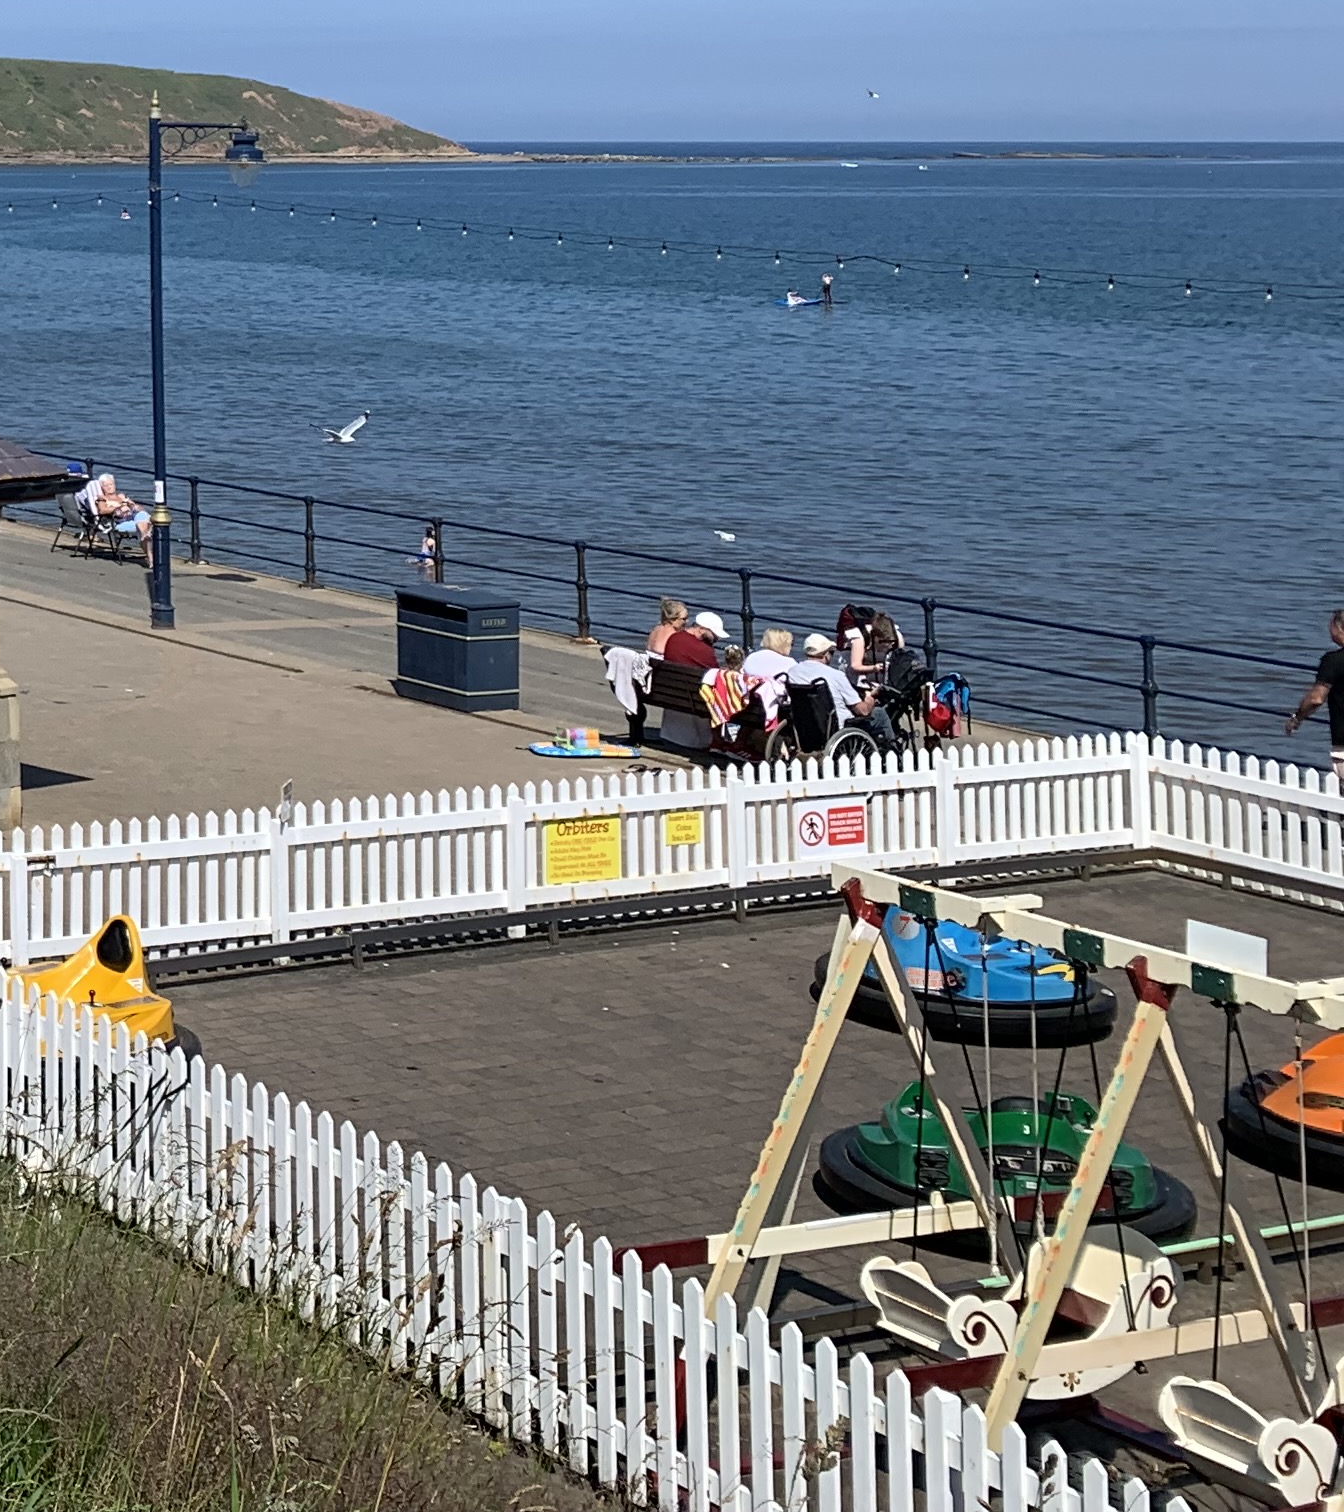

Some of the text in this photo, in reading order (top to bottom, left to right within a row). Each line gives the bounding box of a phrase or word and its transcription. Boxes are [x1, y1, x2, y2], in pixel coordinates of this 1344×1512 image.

[557, 821, 609, 836] Orbiters
[900, 915, 911, 935] 7
[1023, 1124, 1031, 1135] 3
